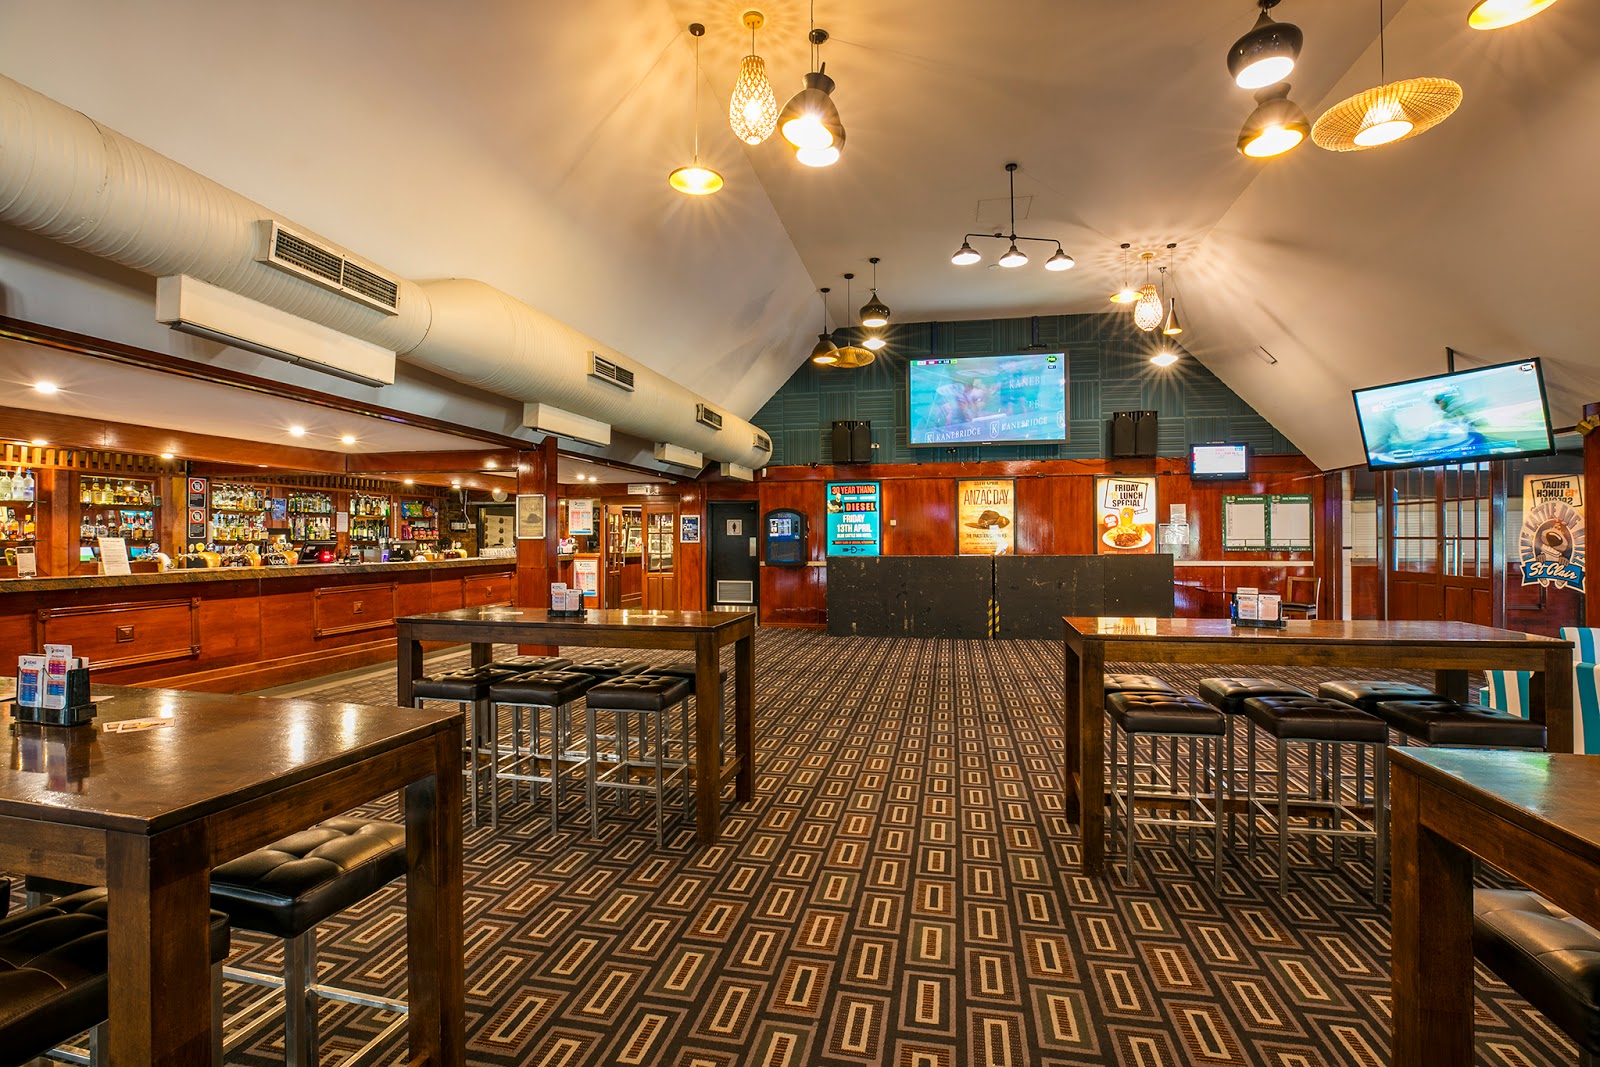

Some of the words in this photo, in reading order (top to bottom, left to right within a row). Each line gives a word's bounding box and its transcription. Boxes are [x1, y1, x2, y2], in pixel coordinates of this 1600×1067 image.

[936, 428, 981, 441] KANEBRIDGE
[1001, 416, 1048, 431] KANEBRIDGE
[831, 486, 841, 495] 30
[841, 486, 856, 494] YEAR
[856, 485, 876, 494] THANG
[963, 489, 992, 506] ANZAC
[993, 488, 1010, 505] DAY
[845, 502, 876, 512] DIESEL
[1112, 499, 1140, 507] SPECIAL
[842, 514, 866, 524] FRIDAY
[1525, 503, 1557, 533] CATTLE
[1558, 504, 1582, 531] DOG
[836, 524, 853, 533] 13TH
[853, 524, 873, 533] APRIL
[1528, 562, 1546, 577] St
[1546, 563, 1577, 580] Clair
